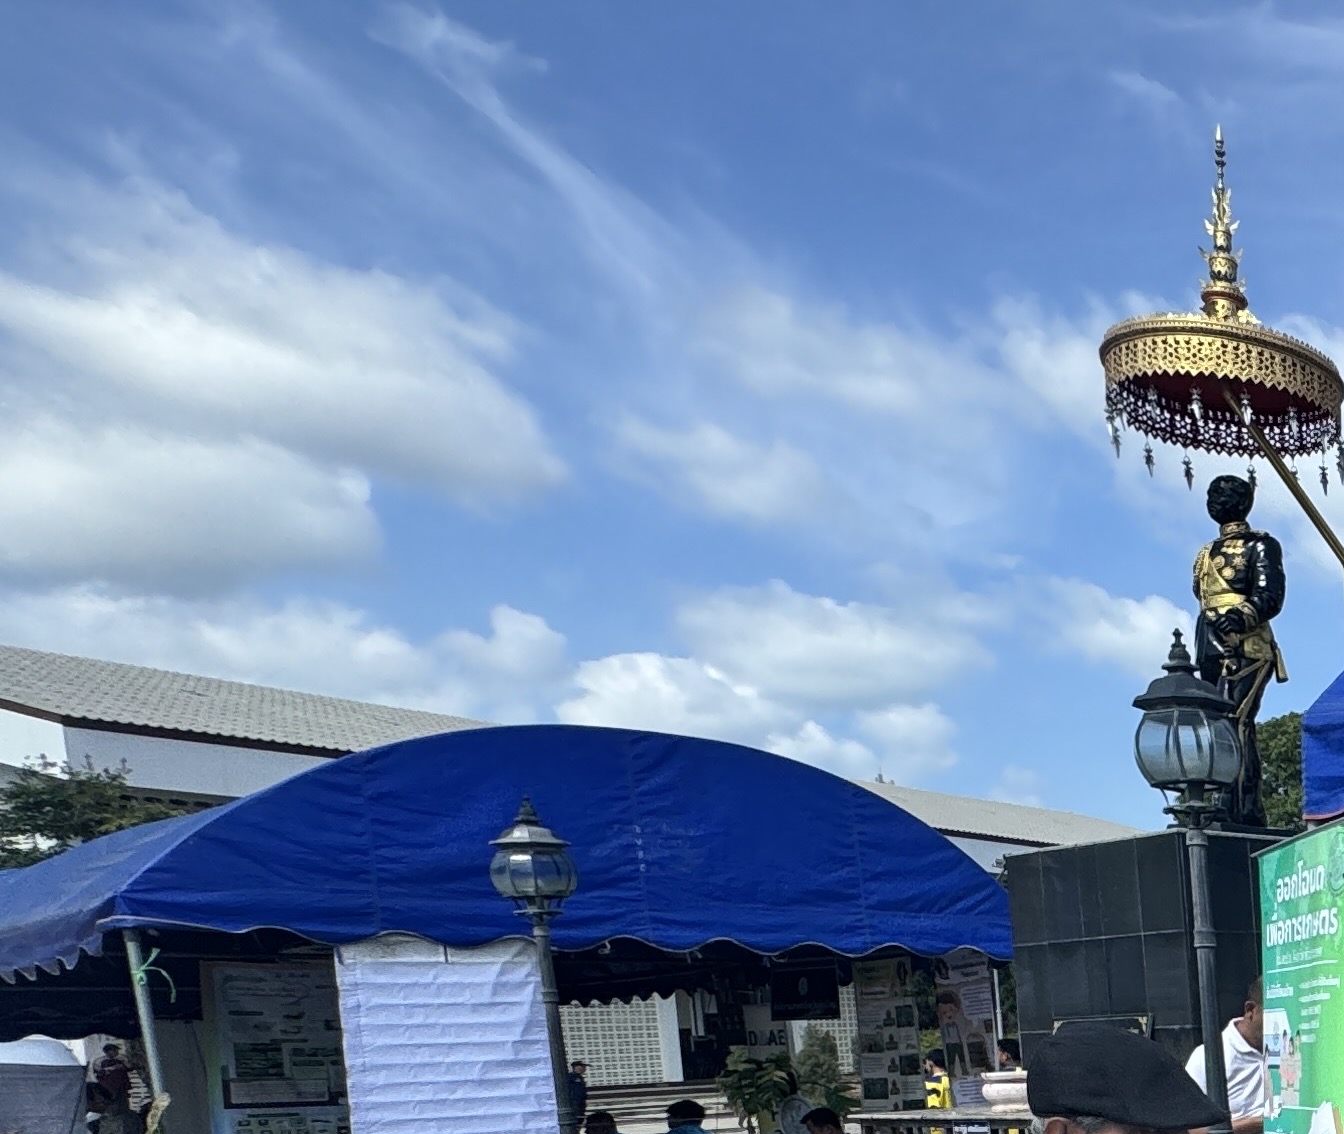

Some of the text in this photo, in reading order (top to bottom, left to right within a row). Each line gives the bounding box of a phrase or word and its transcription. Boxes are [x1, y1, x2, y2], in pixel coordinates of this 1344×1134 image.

[1277, 860, 1326, 902] ออกโฉนด
[1266, 903, 1338, 948] เพื่อการเกษตร
